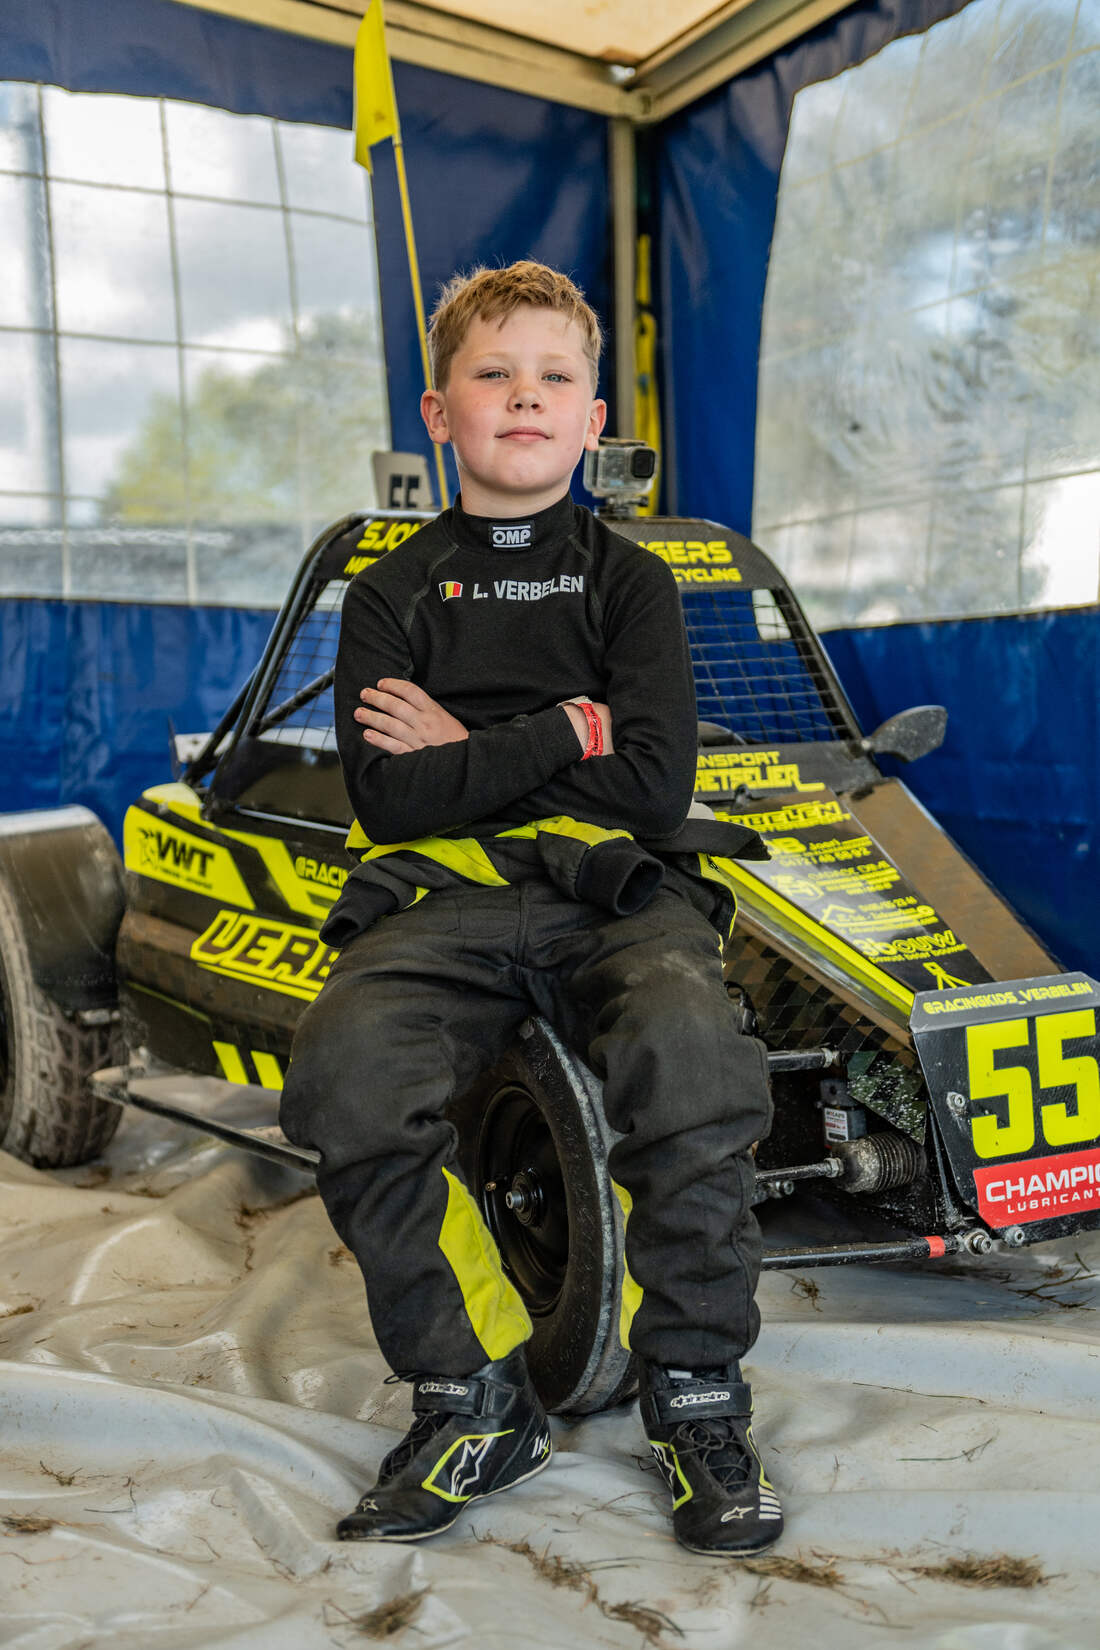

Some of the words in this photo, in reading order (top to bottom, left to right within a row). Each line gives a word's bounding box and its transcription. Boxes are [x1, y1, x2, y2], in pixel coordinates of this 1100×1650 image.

[356, 521, 420, 551] SJO
[492, 529, 531, 545] OMP
[637, 541, 733, 564] GERS
[472, 583, 489, 600] L.
[493, 574, 584, 601] VERBELEN
[696, 750, 780, 769] NSPORT
[966, 1008, 1100, 1160] 55
